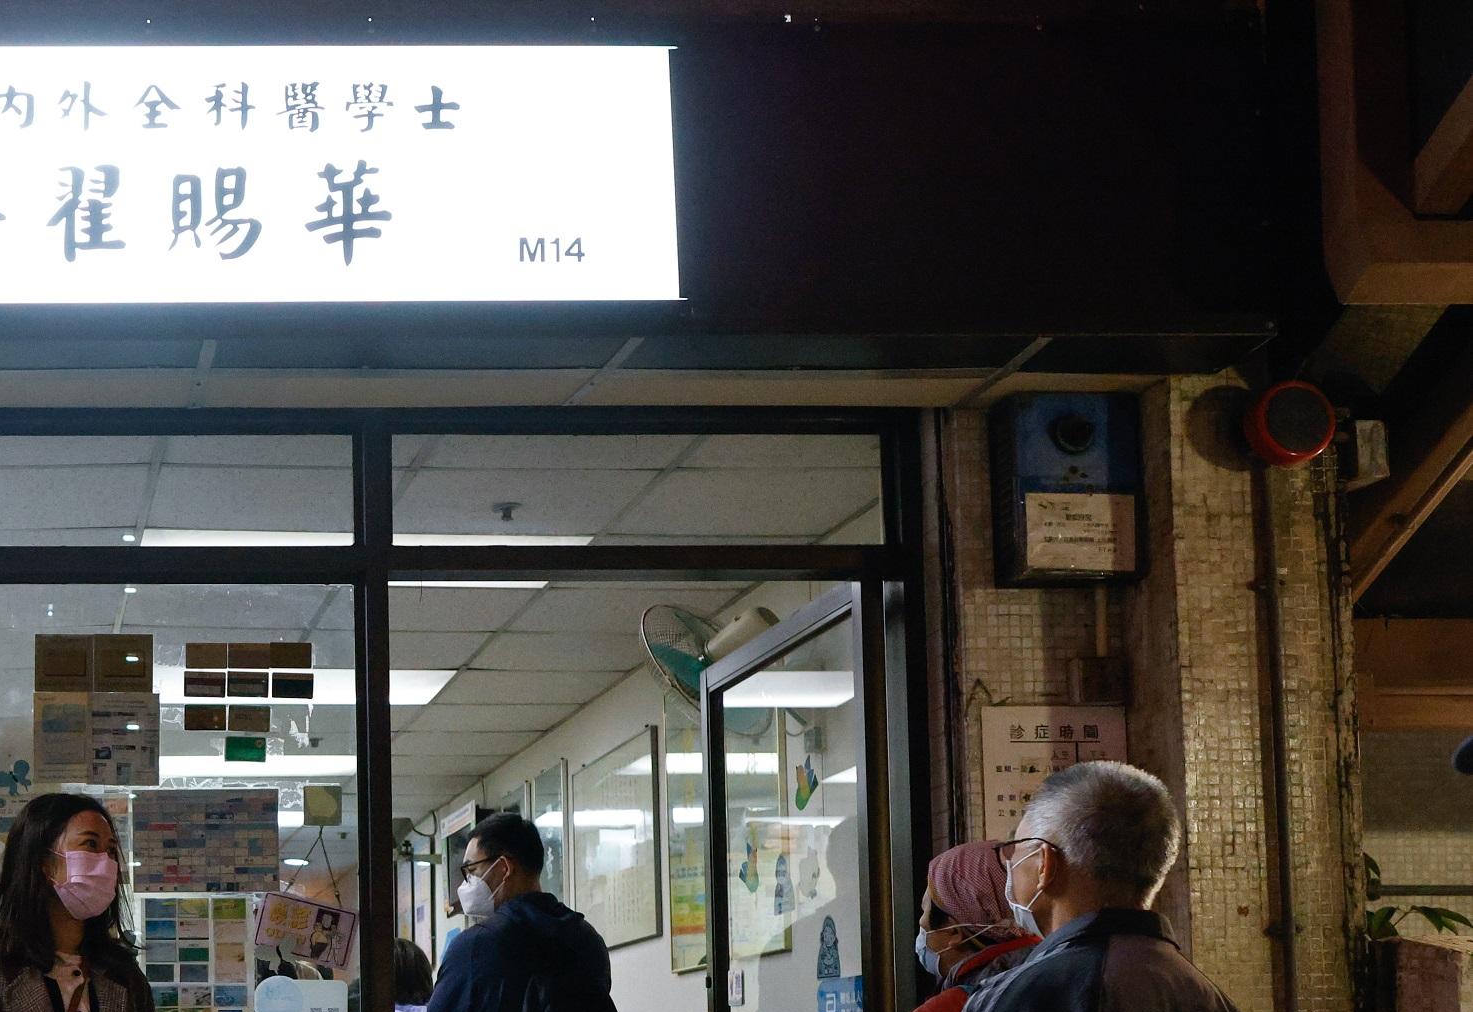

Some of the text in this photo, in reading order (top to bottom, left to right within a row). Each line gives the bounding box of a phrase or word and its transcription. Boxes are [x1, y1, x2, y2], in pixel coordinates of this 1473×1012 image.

[519, 237, 586, 263] M14
[1009, 724, 1099, 740] 診症時間
